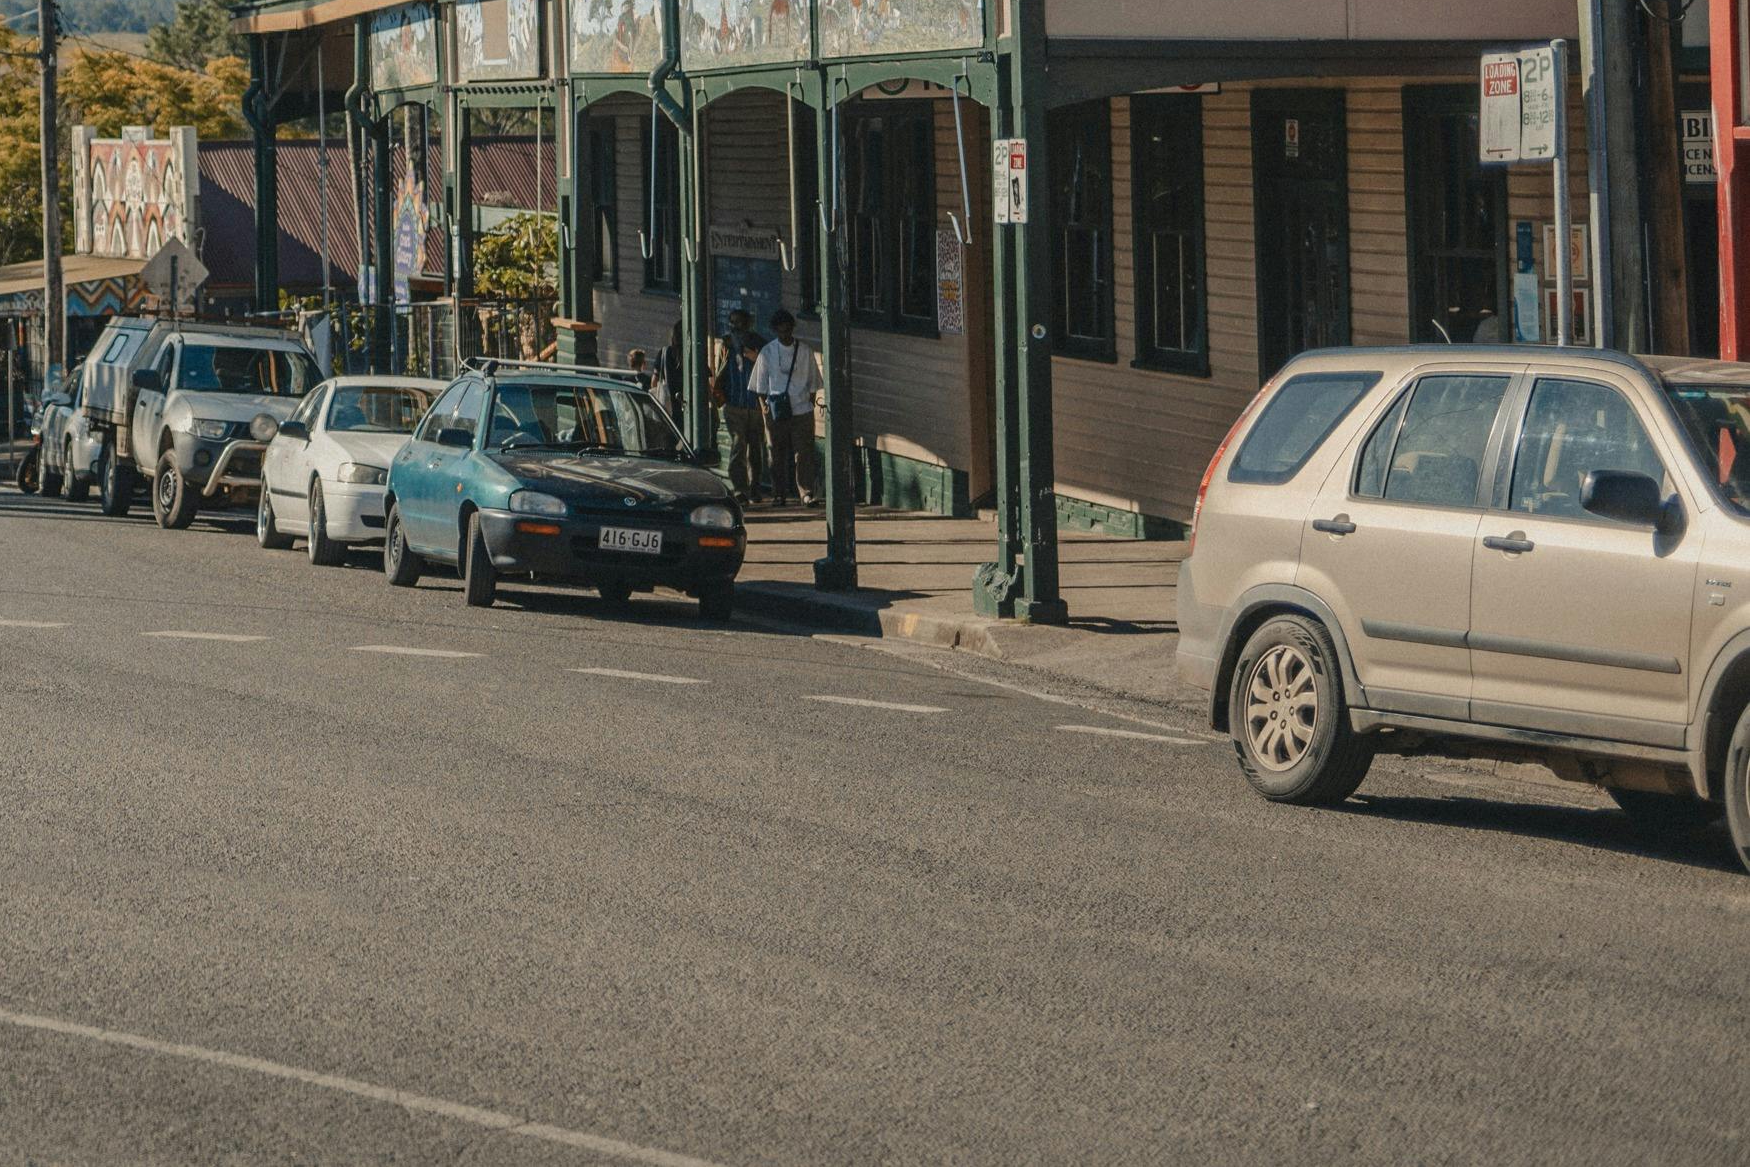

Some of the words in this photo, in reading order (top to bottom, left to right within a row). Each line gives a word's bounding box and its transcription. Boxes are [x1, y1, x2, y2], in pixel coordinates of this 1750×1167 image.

[1485, 63, 1516, 79] LOADING
[1523, 57, 1550, 83] 2P
[1489, 79, 1513, 94] ZONE
[995, 146, 1008, 166] 2P
